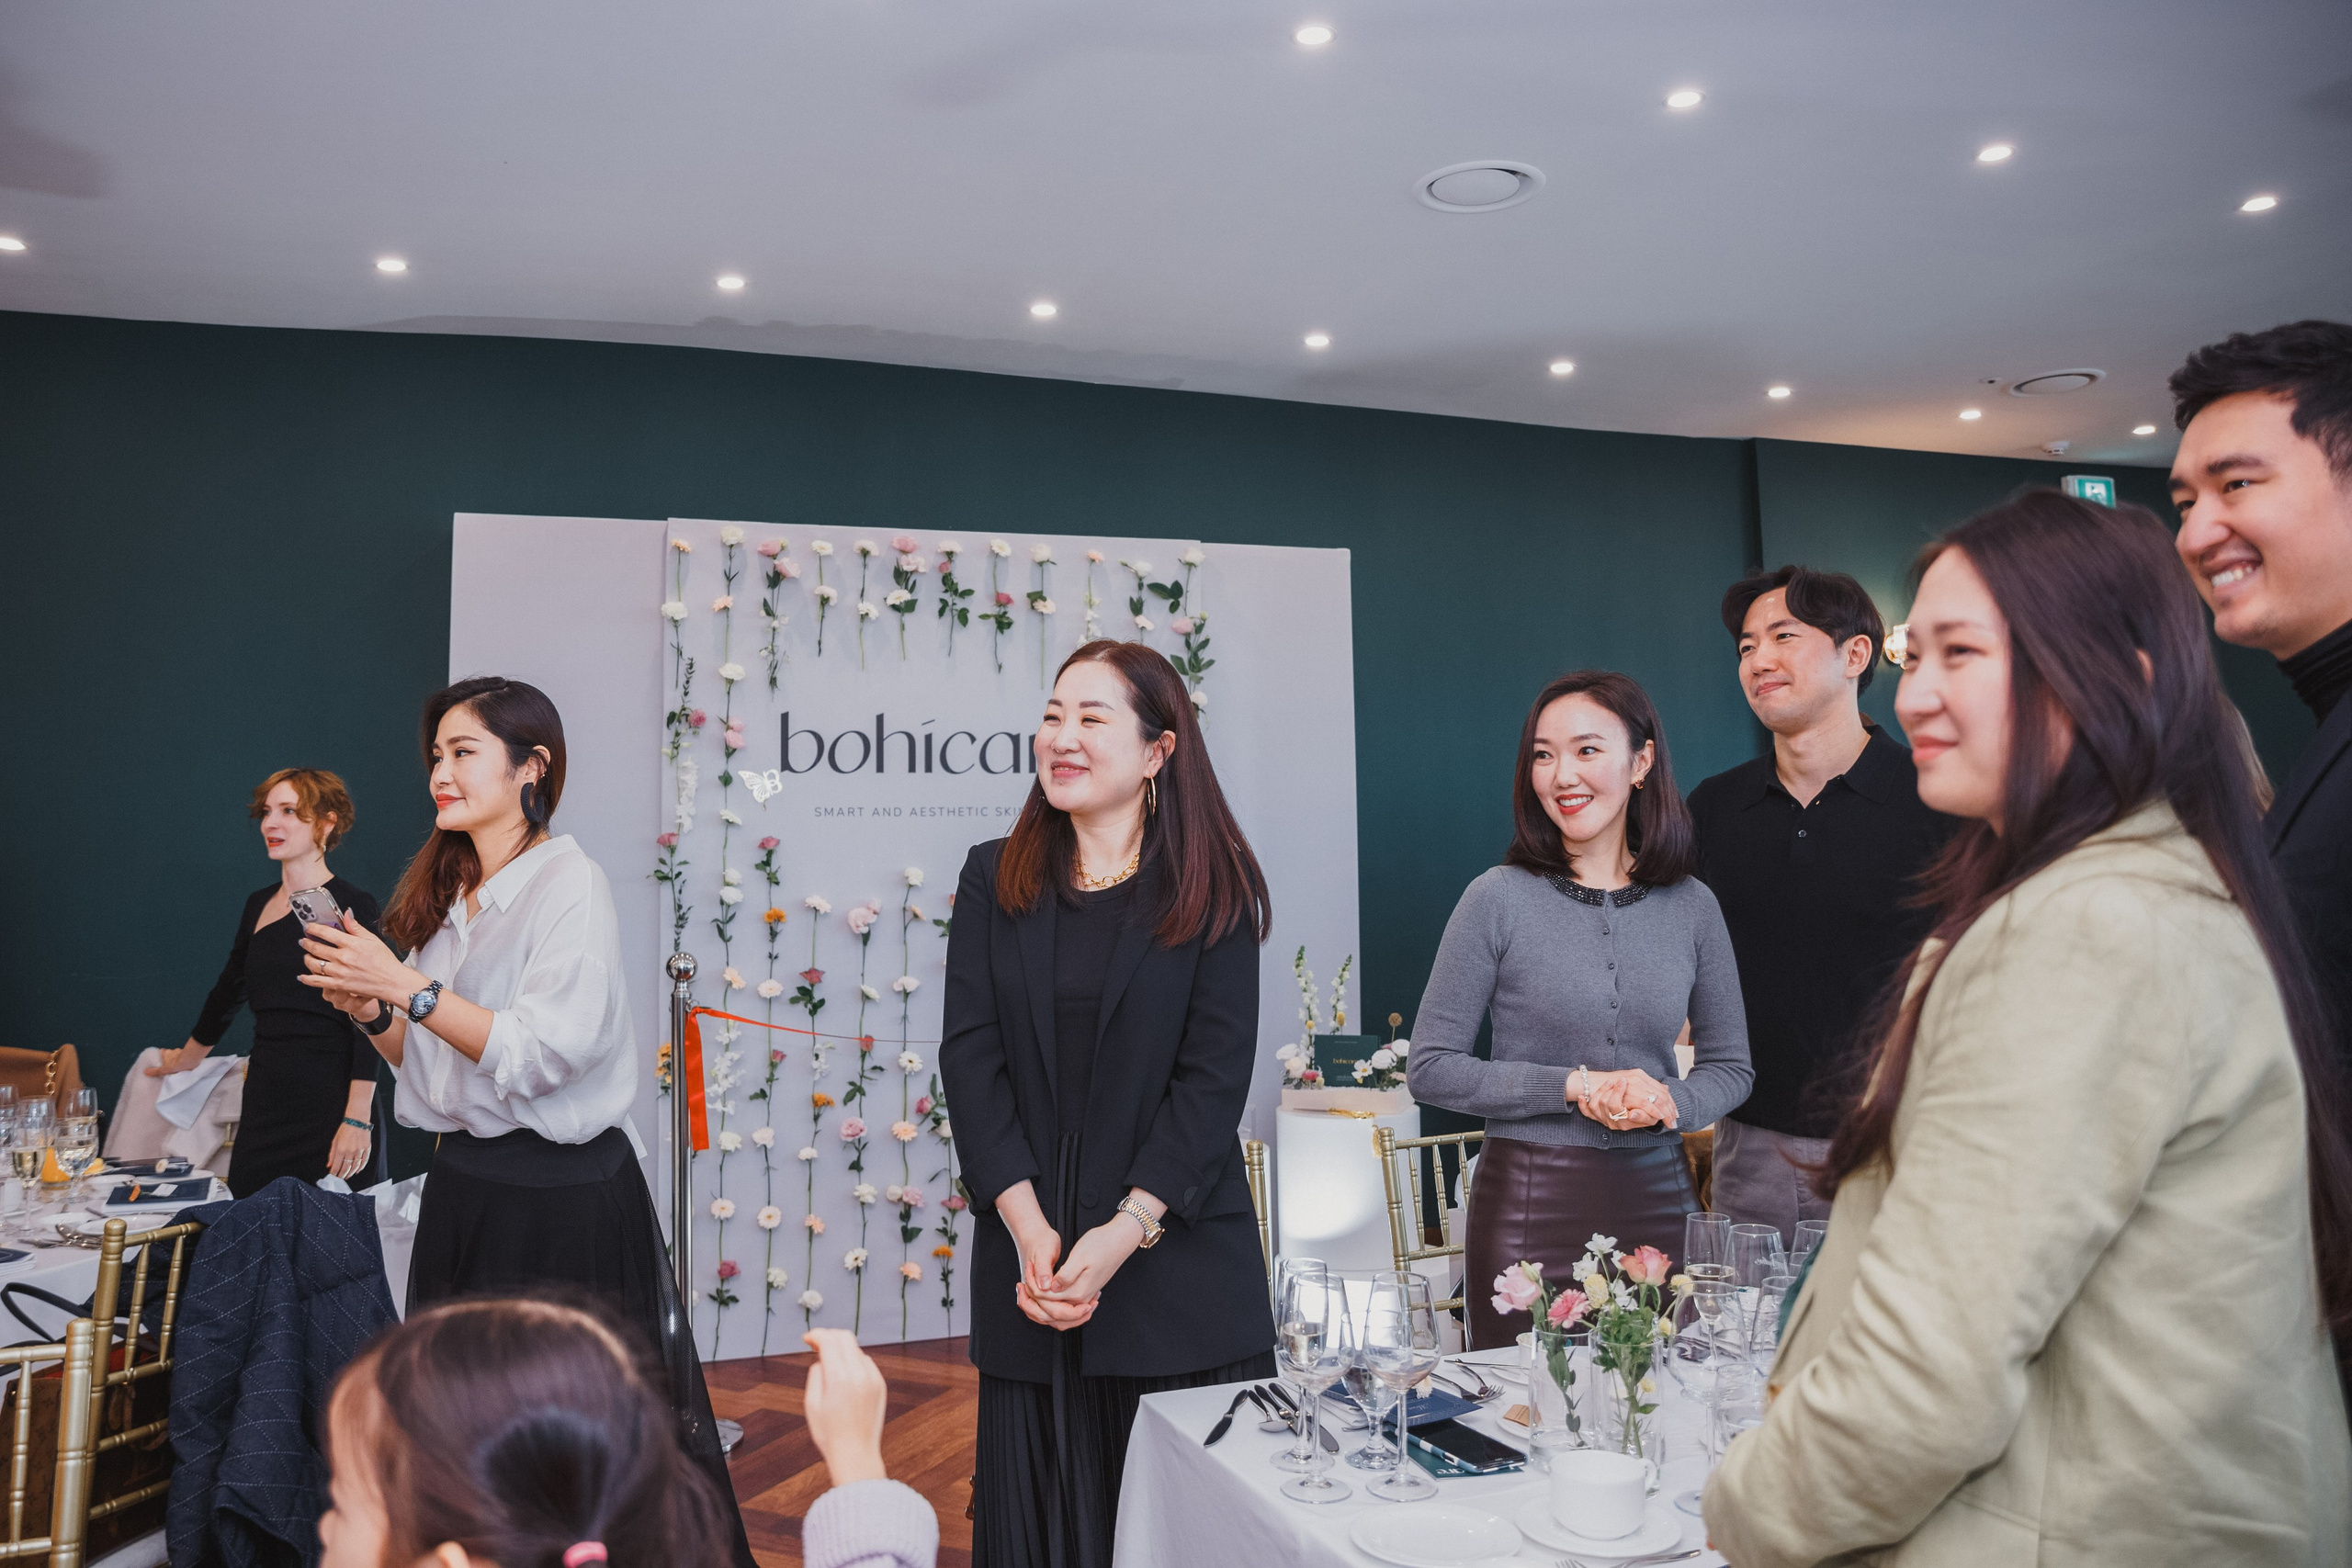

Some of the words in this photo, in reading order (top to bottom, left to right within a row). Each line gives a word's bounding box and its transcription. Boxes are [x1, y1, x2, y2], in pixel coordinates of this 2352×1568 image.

[814, 807, 865, 818] SMART
[872, 807, 902, 818] AND
[910, 807, 989, 818] AESTHETIC
